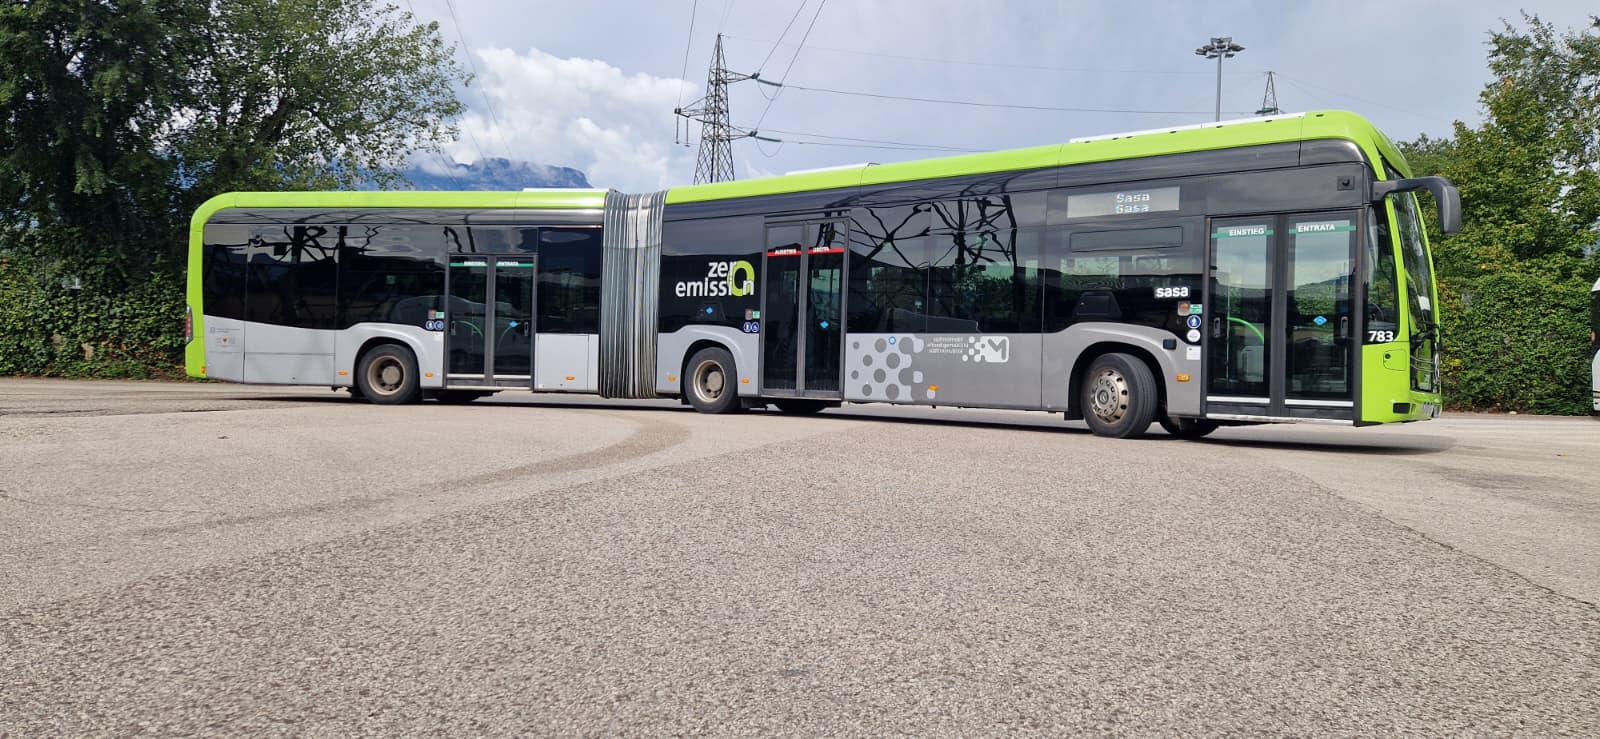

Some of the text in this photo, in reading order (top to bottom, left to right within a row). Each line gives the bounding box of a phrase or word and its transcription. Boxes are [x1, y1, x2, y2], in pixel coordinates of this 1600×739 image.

[1116, 193, 1150, 203] Sasa
[1228, 228, 1265, 236] EINSTIEG
[1298, 224, 1336, 232] ENTRATA
[675, 276, 755, 297] emission
[1156, 287, 1189, 298] sasa
[1368, 331, 1394, 342] 783
